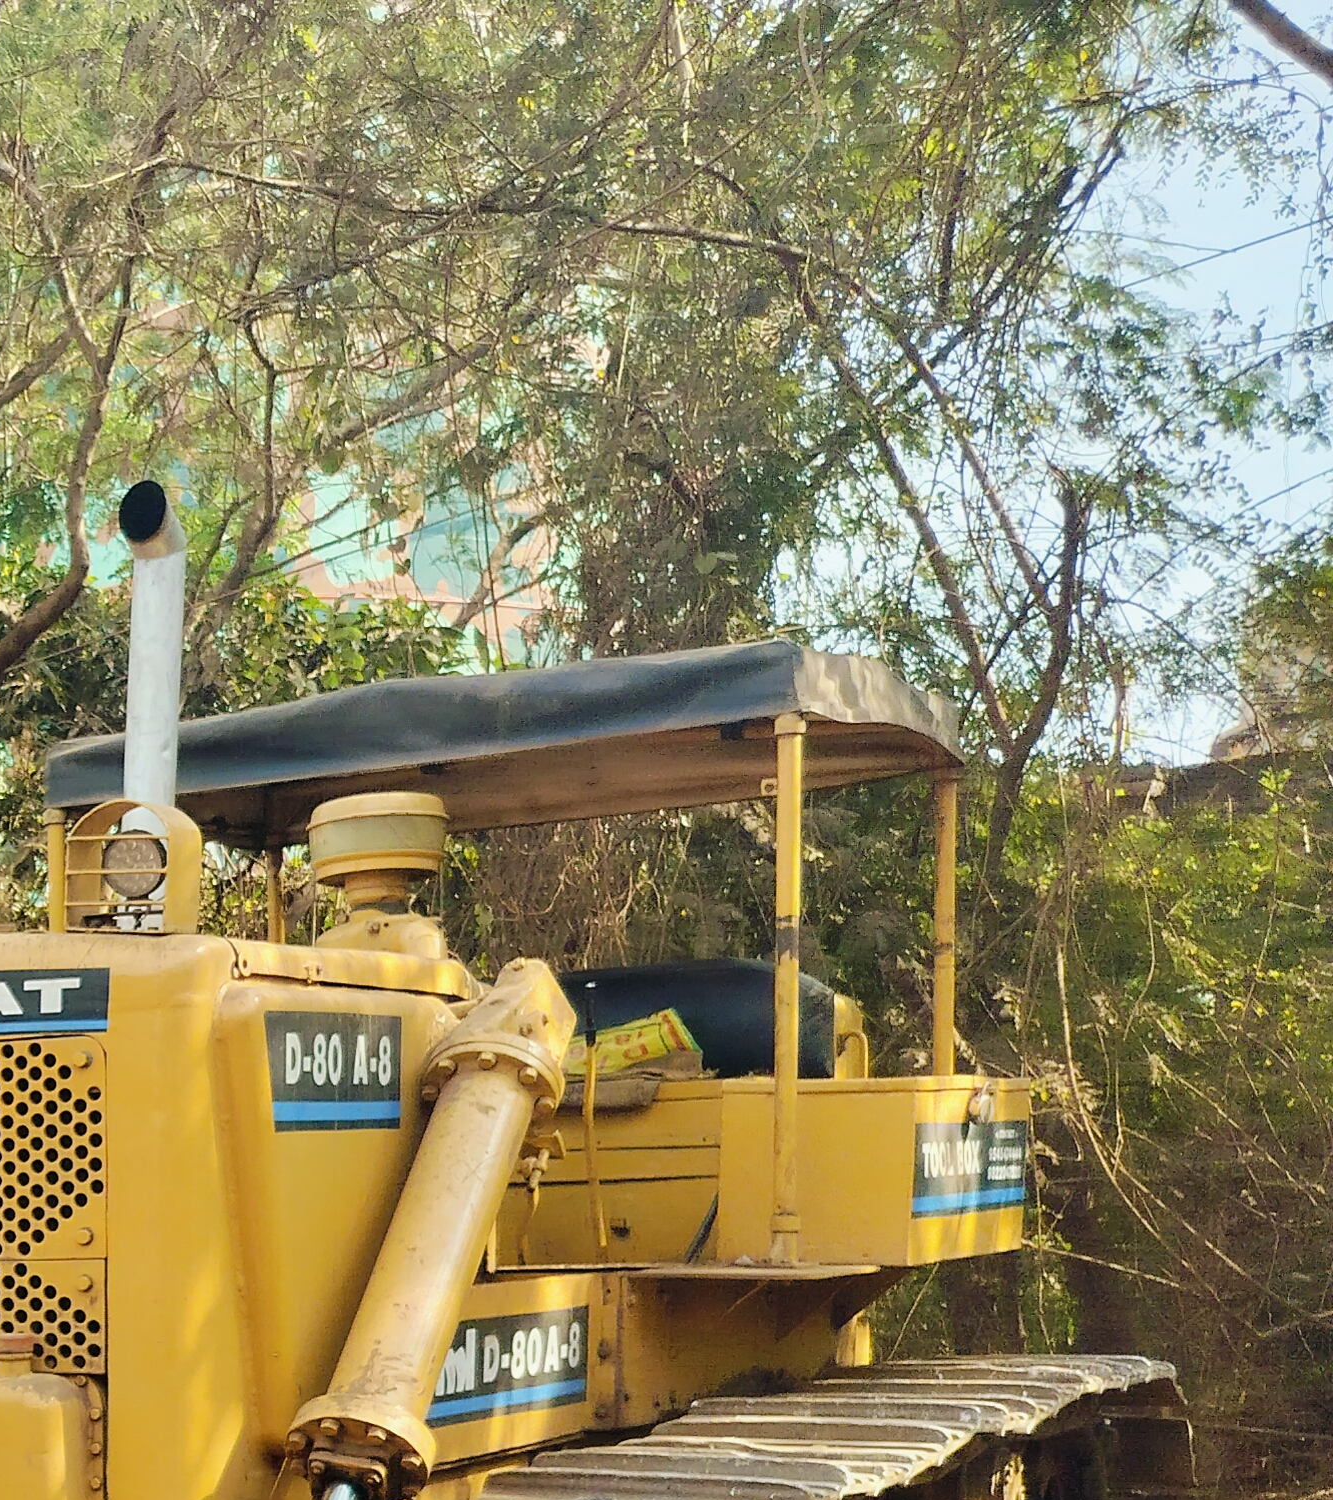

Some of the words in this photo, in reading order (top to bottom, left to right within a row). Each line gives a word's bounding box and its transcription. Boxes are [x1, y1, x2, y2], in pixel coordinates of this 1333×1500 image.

[285, 1031, 343, 1087] D-80
[352, 1034, 392, 1087] A-8
[921, 1140, 955, 1178] TOOL
[956, 1139, 981, 1175] BOX
[435, 1328, 477, 1397] ml
